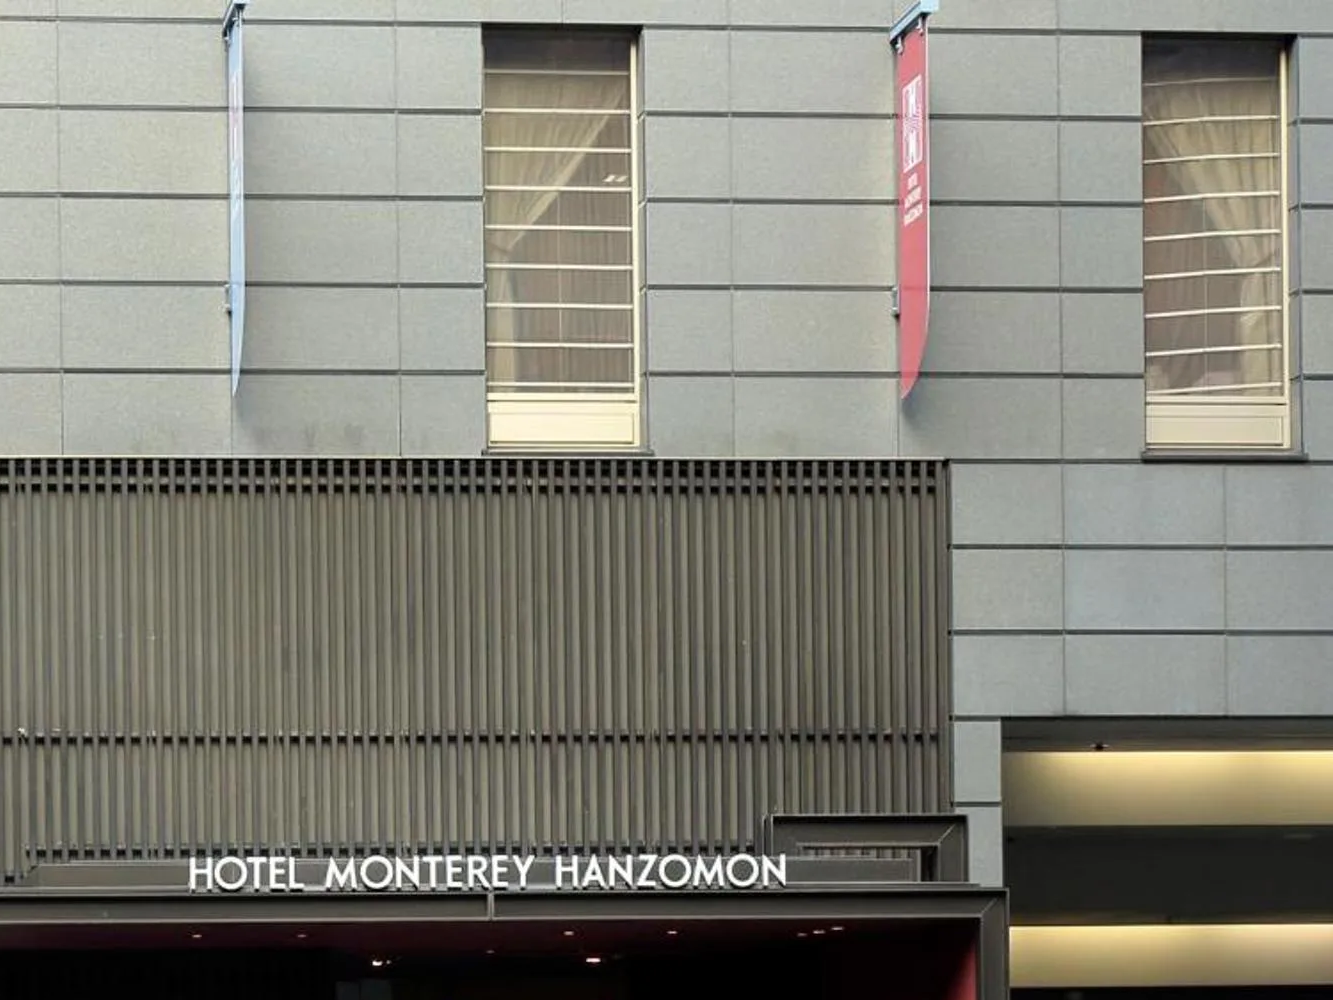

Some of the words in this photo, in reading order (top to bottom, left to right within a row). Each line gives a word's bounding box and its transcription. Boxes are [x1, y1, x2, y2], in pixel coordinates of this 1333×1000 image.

[188, 855, 304, 891] HOTEL
[325, 854, 535, 891] MONTEREY
[555, 853, 786, 888] HANZOMON
